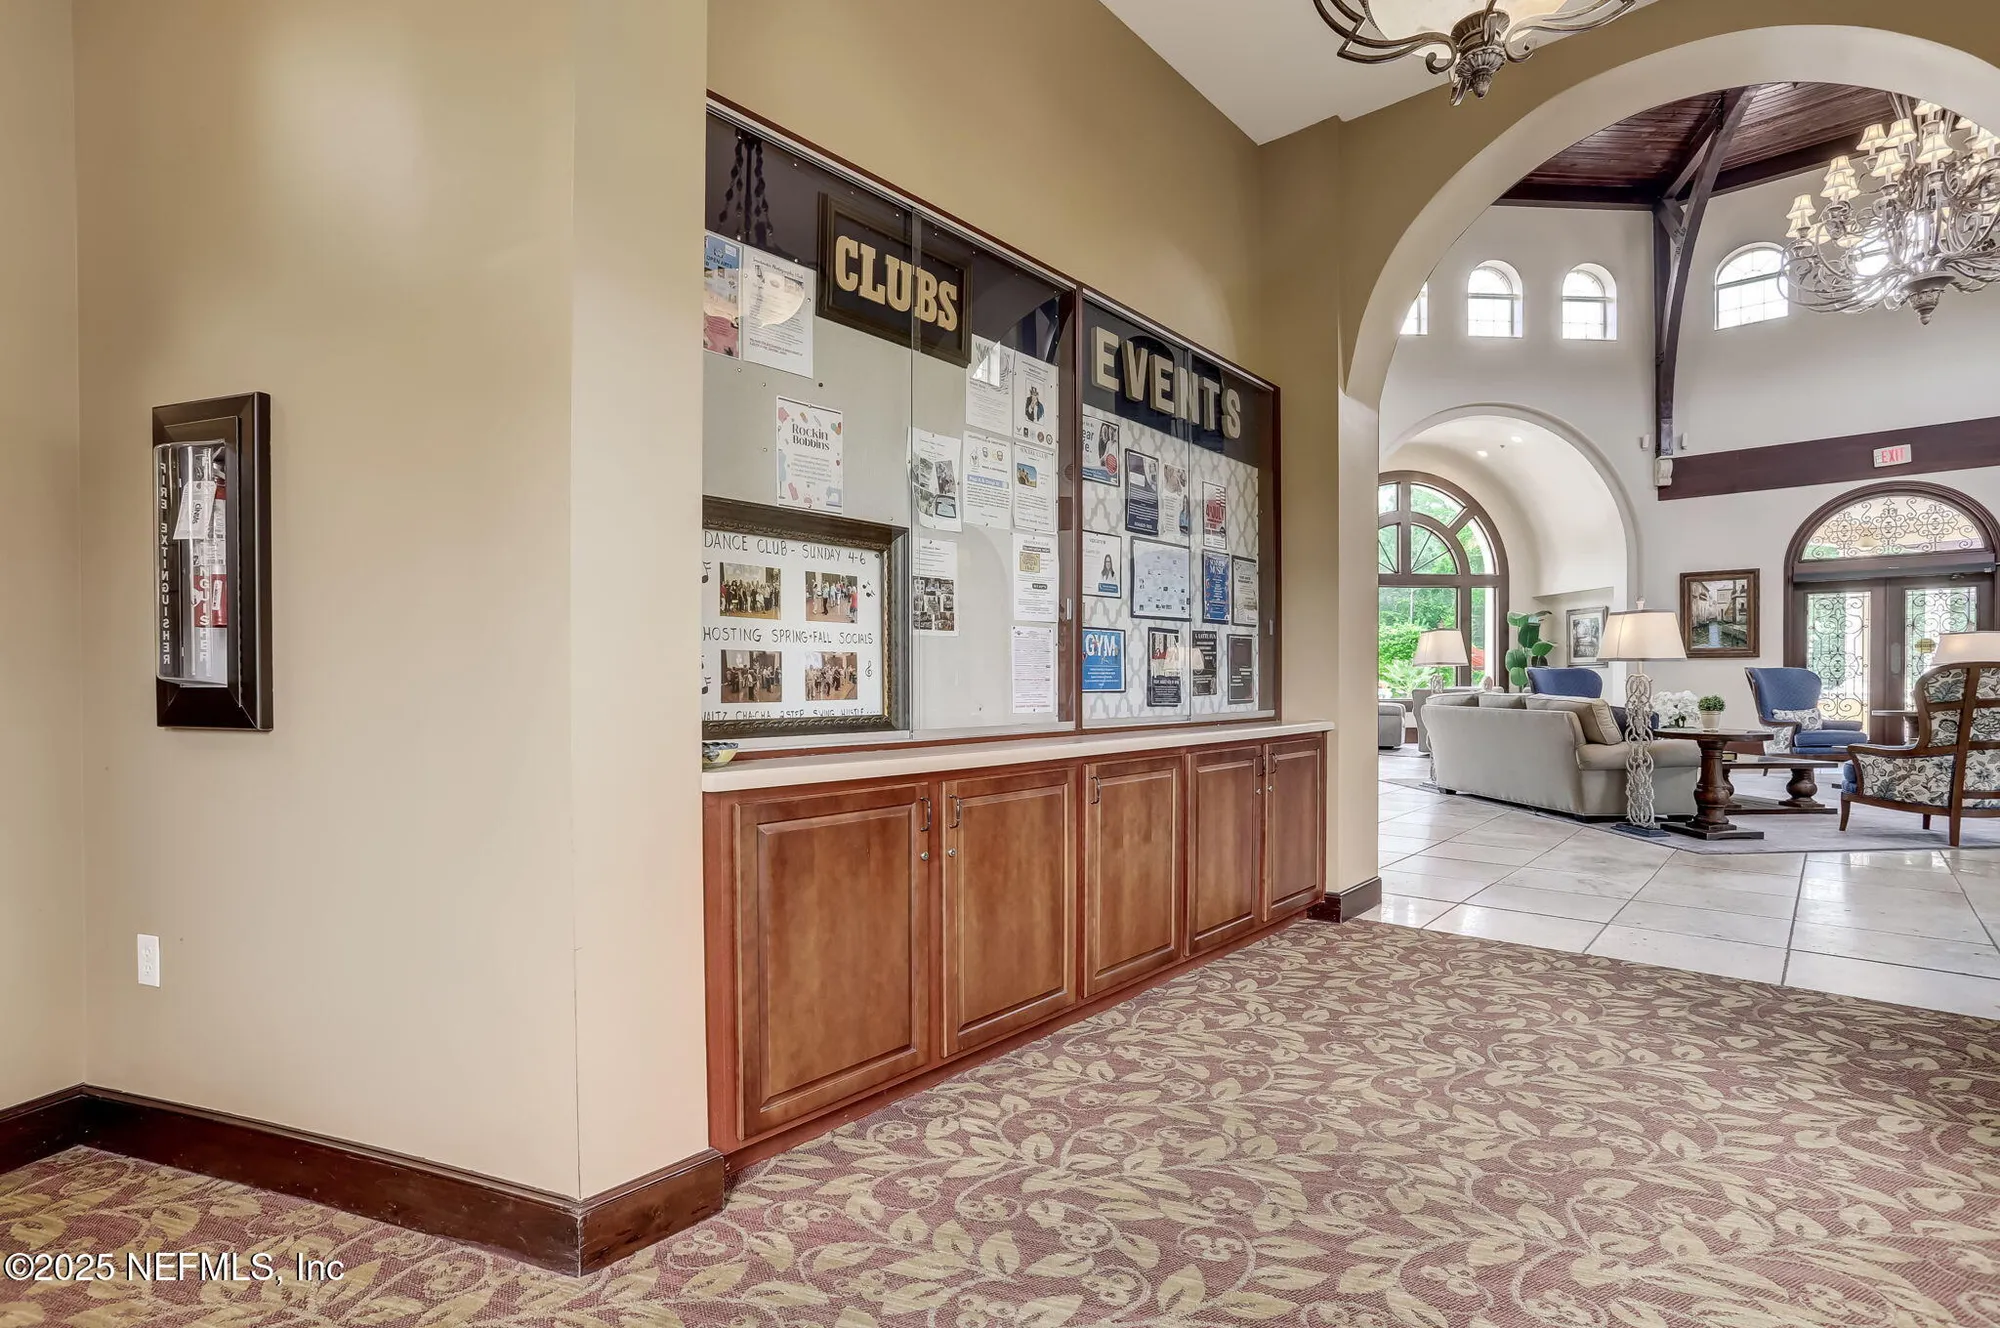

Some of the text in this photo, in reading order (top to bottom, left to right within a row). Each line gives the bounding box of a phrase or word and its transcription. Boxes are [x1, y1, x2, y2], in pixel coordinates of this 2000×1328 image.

[835, 235, 958, 331] CLUBS
[1091, 326, 1241, 439] EVENTS
[792, 423, 829, 441] Rockin
[792, 434, 830, 451] Bobbins
[1881, 447, 1905, 463] EXIT
[704, 530, 748, 551] DANCE
[757, 539, 787, 556] CLUB
[801, 544, 841, 562] SUNDAY
[702, 626, 762, 643] HOSTING
[839, 632, 874, 645] SOCIALS
[1085, 633, 1116, 657] GYM
